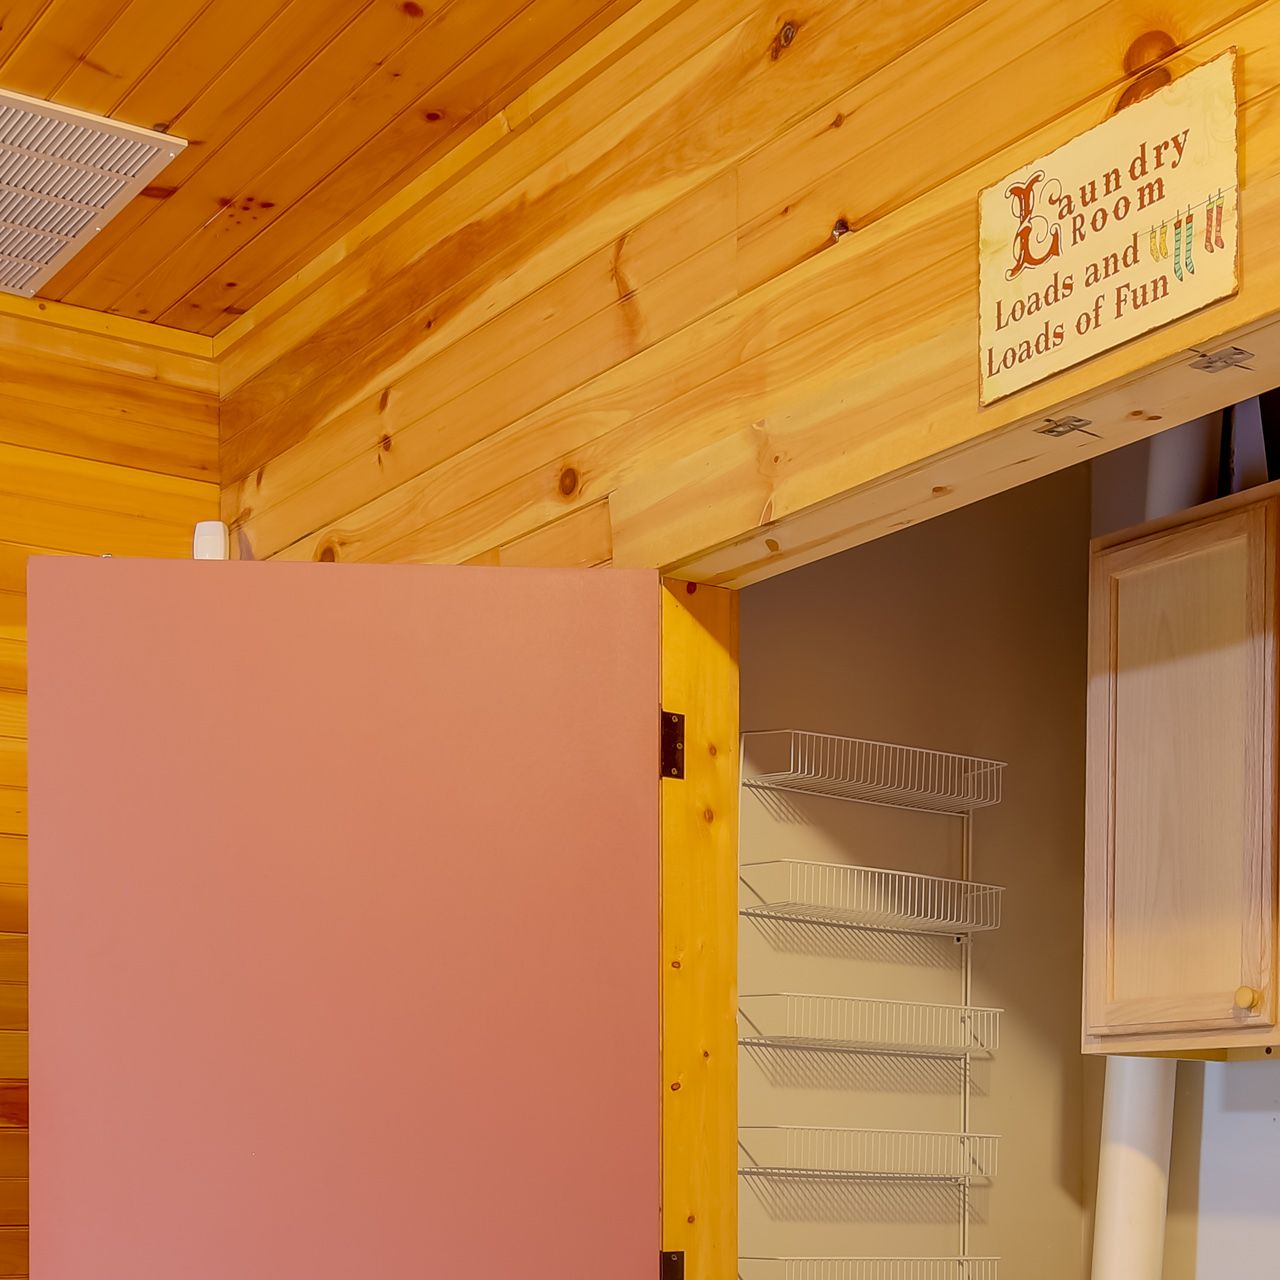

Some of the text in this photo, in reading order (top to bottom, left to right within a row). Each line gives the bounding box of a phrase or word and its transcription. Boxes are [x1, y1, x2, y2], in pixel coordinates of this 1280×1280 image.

[1005, 128, 1190, 281] Laundry
[987, 274, 1169, 378] Loads of Fun
[995, 231, 1139, 331] Loads and
